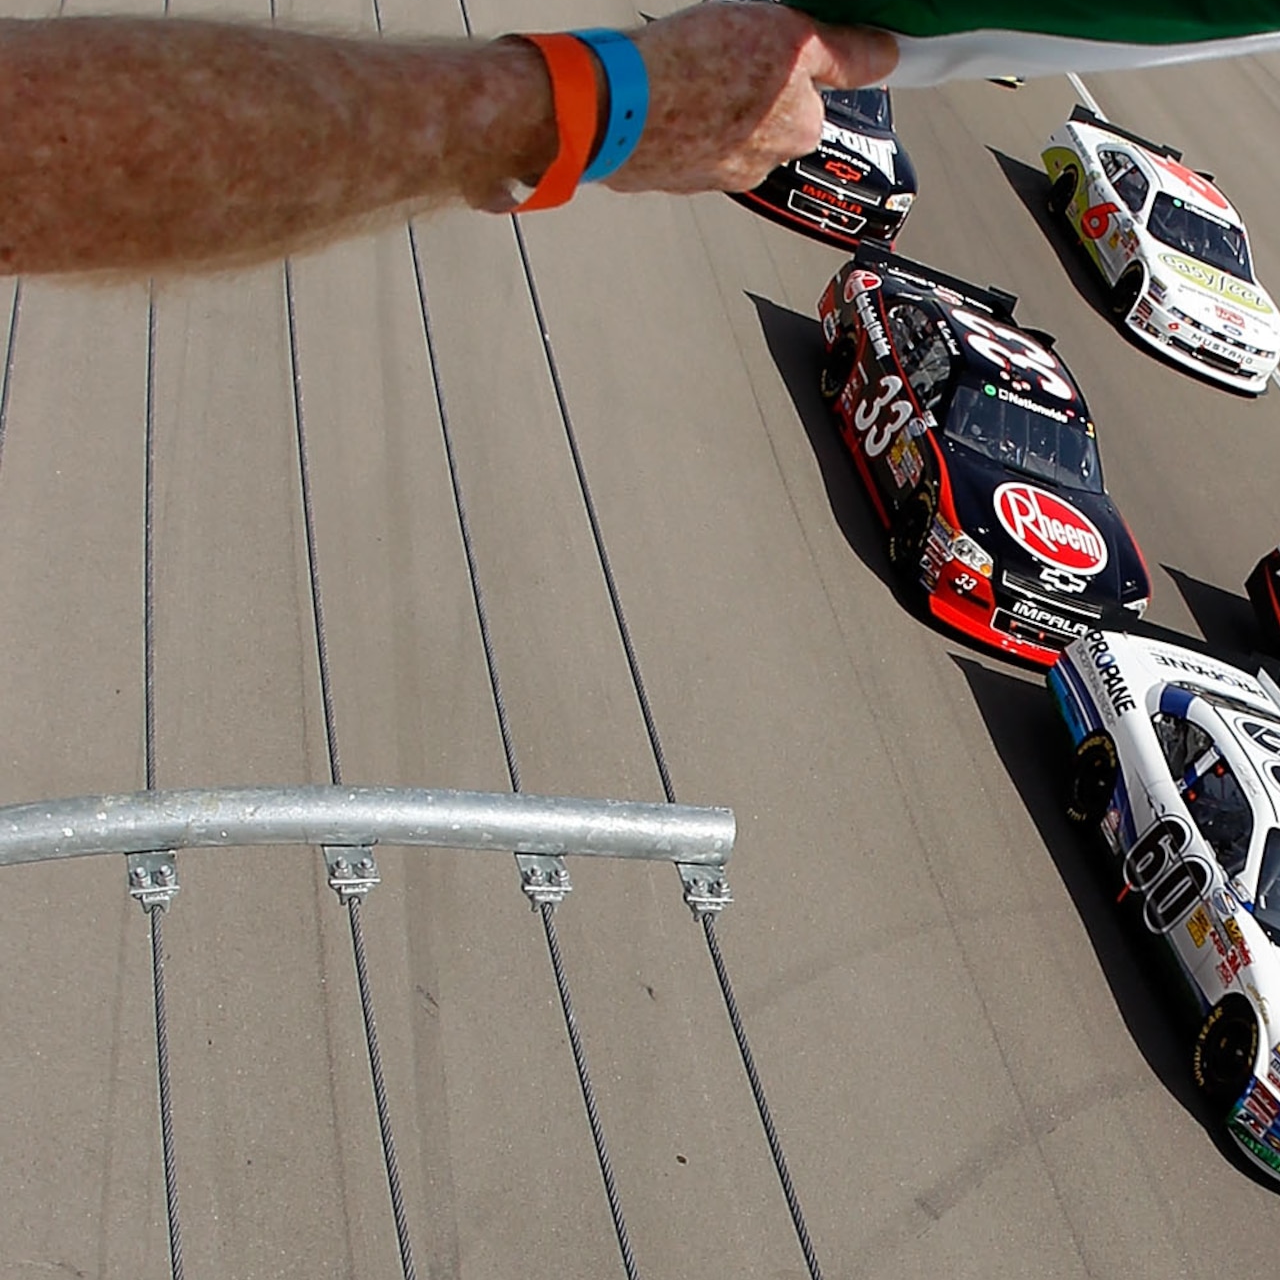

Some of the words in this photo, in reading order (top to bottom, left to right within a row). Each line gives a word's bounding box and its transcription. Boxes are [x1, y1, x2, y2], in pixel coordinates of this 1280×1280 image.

[802, 184, 862, 214] IMPALA
[1081, 202, 1121, 240] 6
[950, 308, 1076, 401] 33
[1192, 333, 1253, 365] MUSTANG
[855, 375, 914, 457] 33
[1009, 391, 1069, 423] Nationwide
[1002, 486, 1103, 563] Rheem
[954, 573, 978, 591] 33
[1012, 601, 1088, 635] IMPALA
[1084, 629, 1137, 718] PROPANE
[1150, 652, 1269, 701] PROPANE
[1123, 814, 1213, 934] 60
